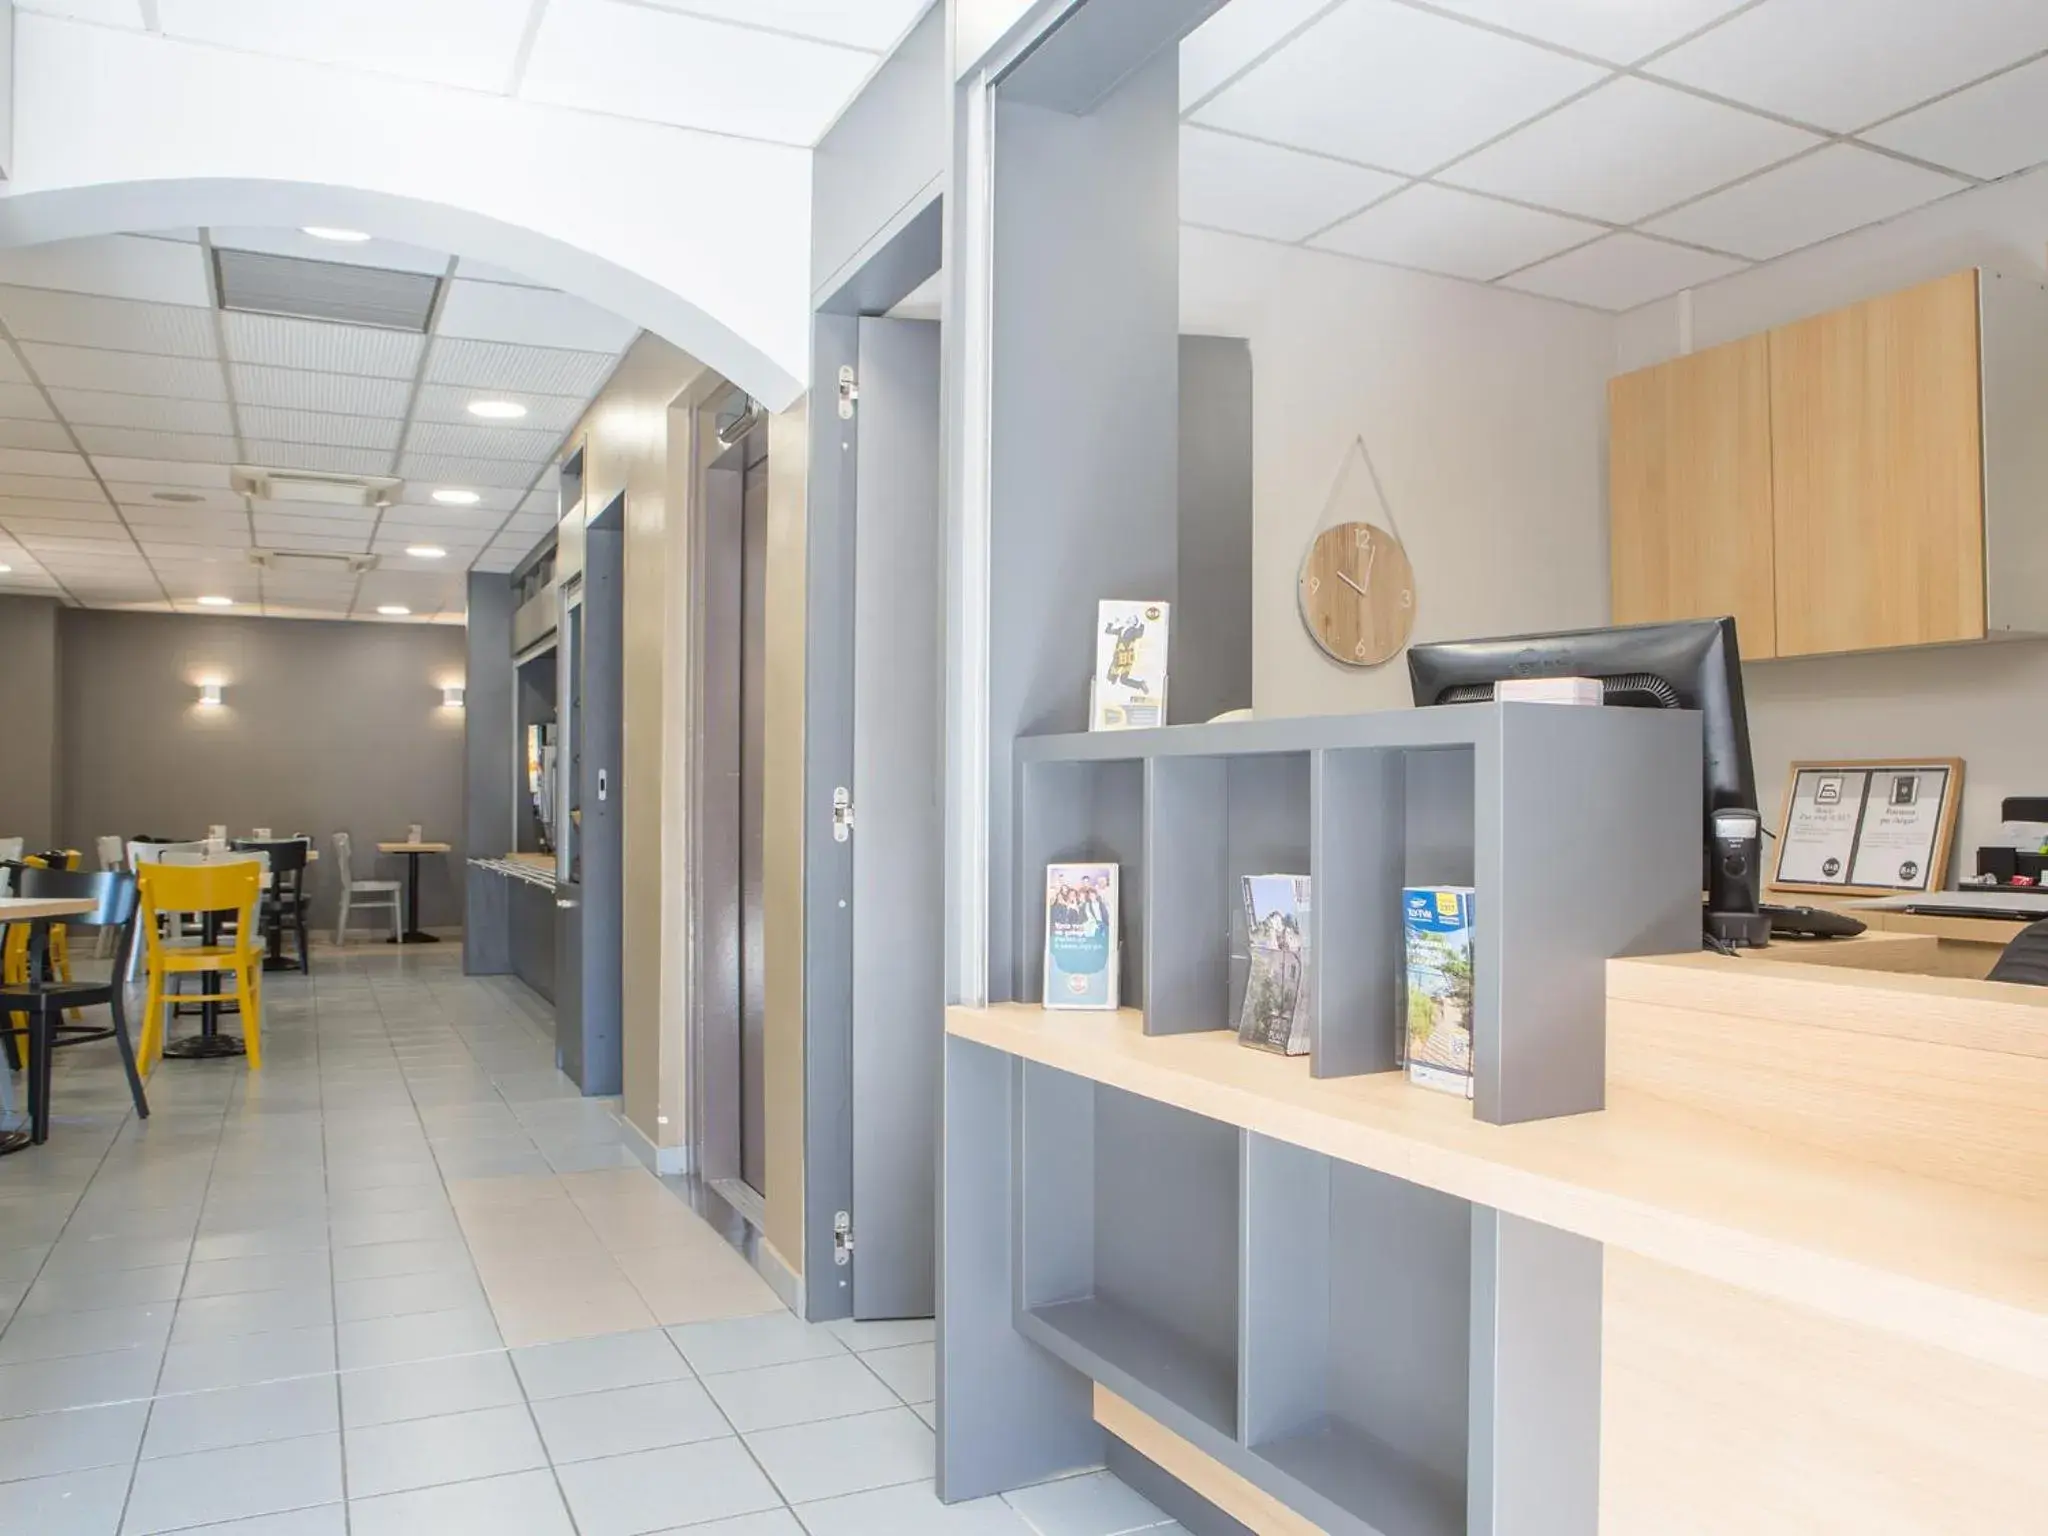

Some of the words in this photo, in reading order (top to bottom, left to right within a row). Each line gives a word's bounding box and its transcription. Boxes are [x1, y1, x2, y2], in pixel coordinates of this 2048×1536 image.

[1354, 528, 1370, 549] 12
[1309, 577, 1321, 595] 9
[1400, 589, 1412, 608] 3
[1355, 637, 1366, 657] 6
